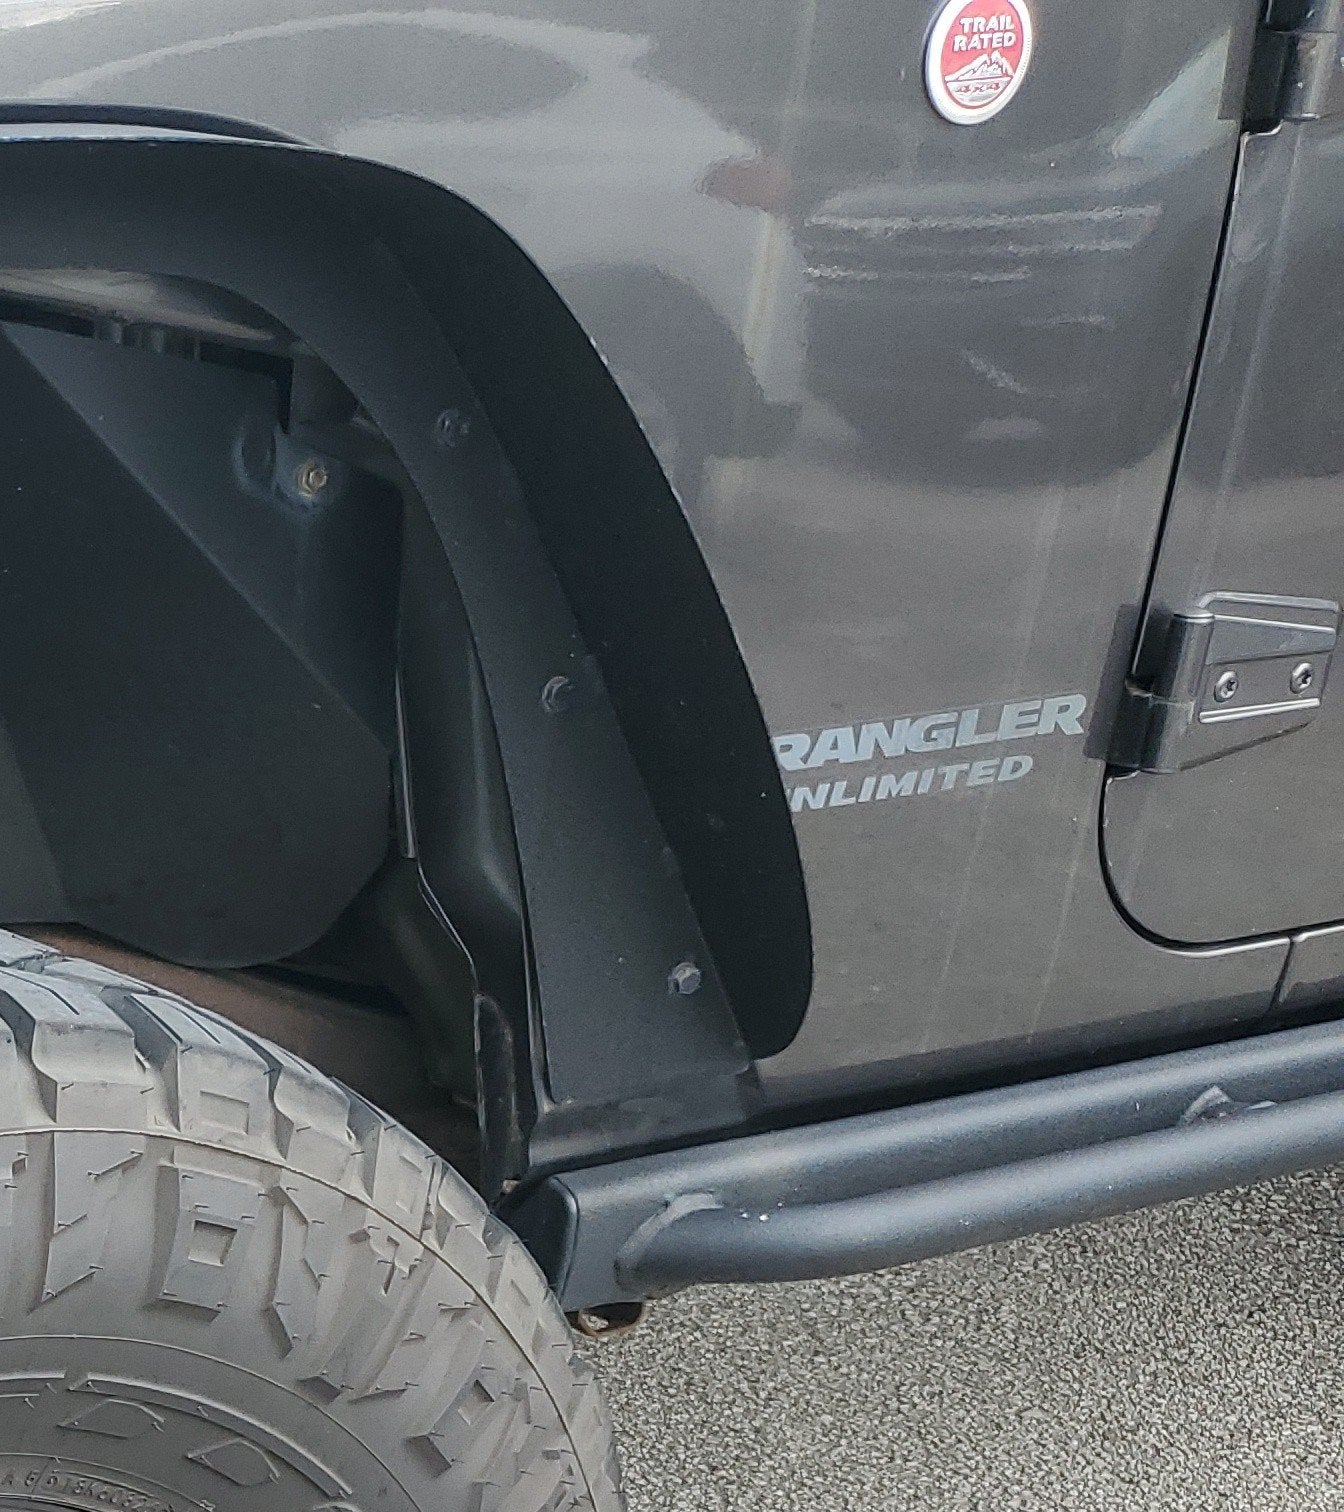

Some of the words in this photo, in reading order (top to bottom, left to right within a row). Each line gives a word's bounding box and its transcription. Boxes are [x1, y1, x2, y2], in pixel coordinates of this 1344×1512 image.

[953, 32, 1017, 51] RATED
[959, 15, 1015, 34] TRAIL
[772, 693, 1087, 772] RANGLER
[785, 755, 1034, 813] NLIMITED
